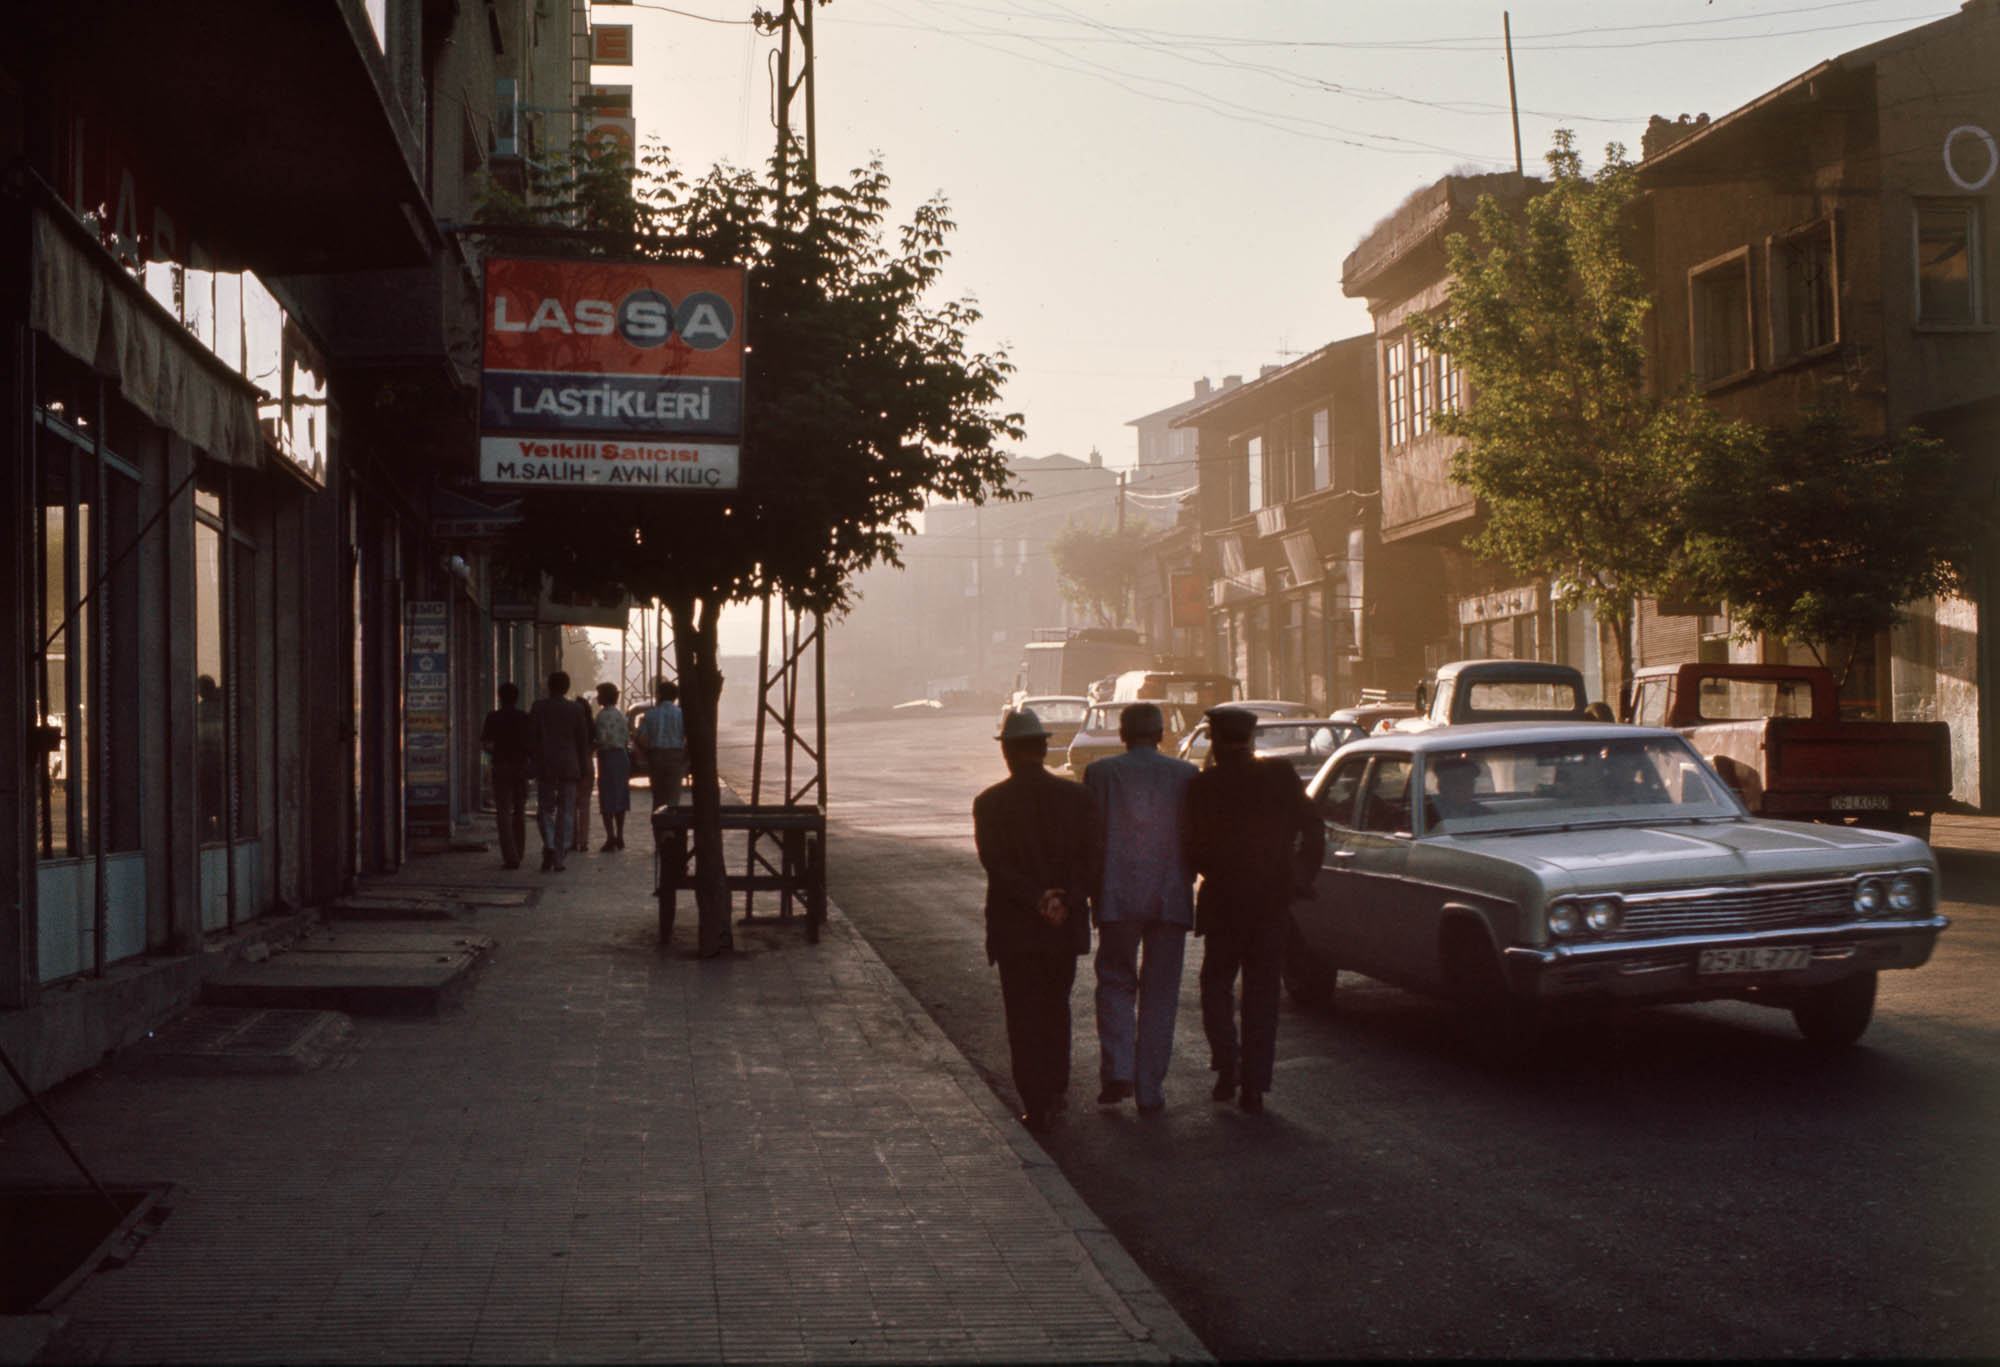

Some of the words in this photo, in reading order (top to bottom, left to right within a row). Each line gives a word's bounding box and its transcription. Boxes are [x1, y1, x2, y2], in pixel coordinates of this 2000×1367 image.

[494, 296, 728, 341] LASSA
[513, 382, 711, 421] LASTİKLERİ
[520, 441, 596, 460] Yetkili
[601, 443, 699, 463] Satıcısı
